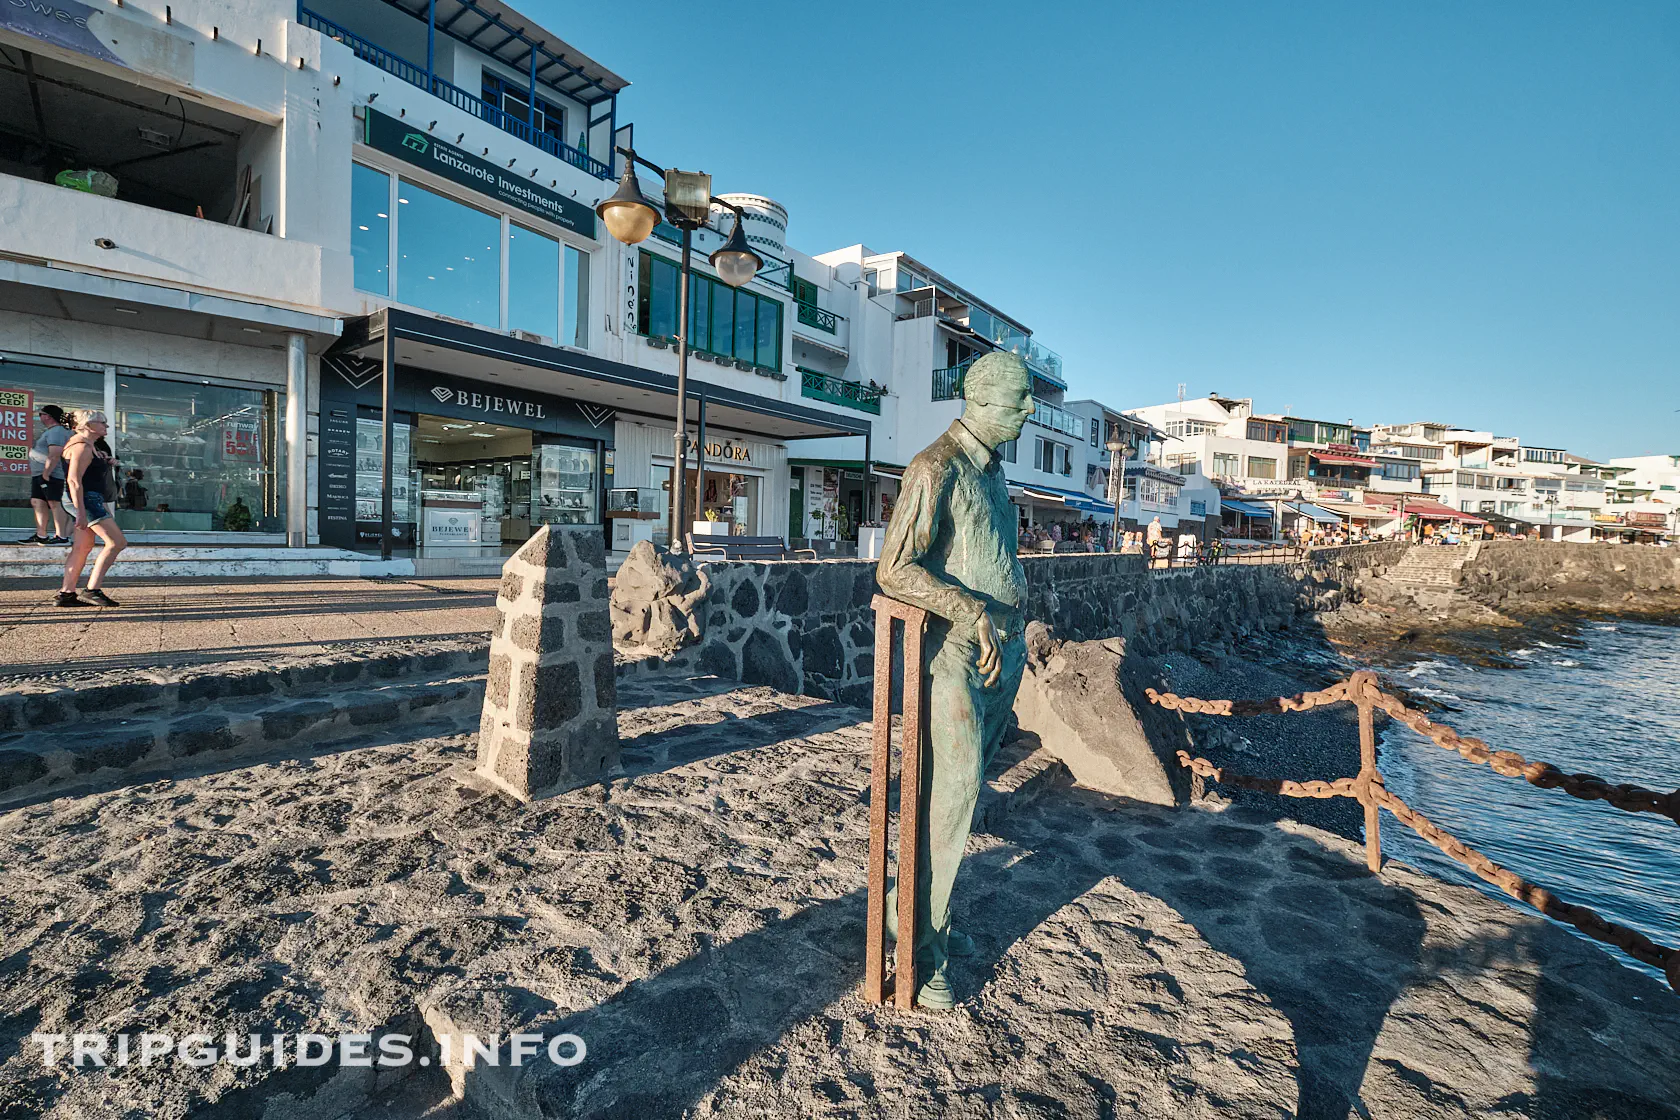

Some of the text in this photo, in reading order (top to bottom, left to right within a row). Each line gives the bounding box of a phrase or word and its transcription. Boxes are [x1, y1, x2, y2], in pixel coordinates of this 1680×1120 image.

[433, 147, 563, 214] Lanzarote Investments
[498, 190, 528, 206] connecting
[527, 202, 545, 213] people
[555, 214, 575, 226] property
[456, 390, 546, 419] BEJEWEL
[9, 463, 28, 472] OFF
